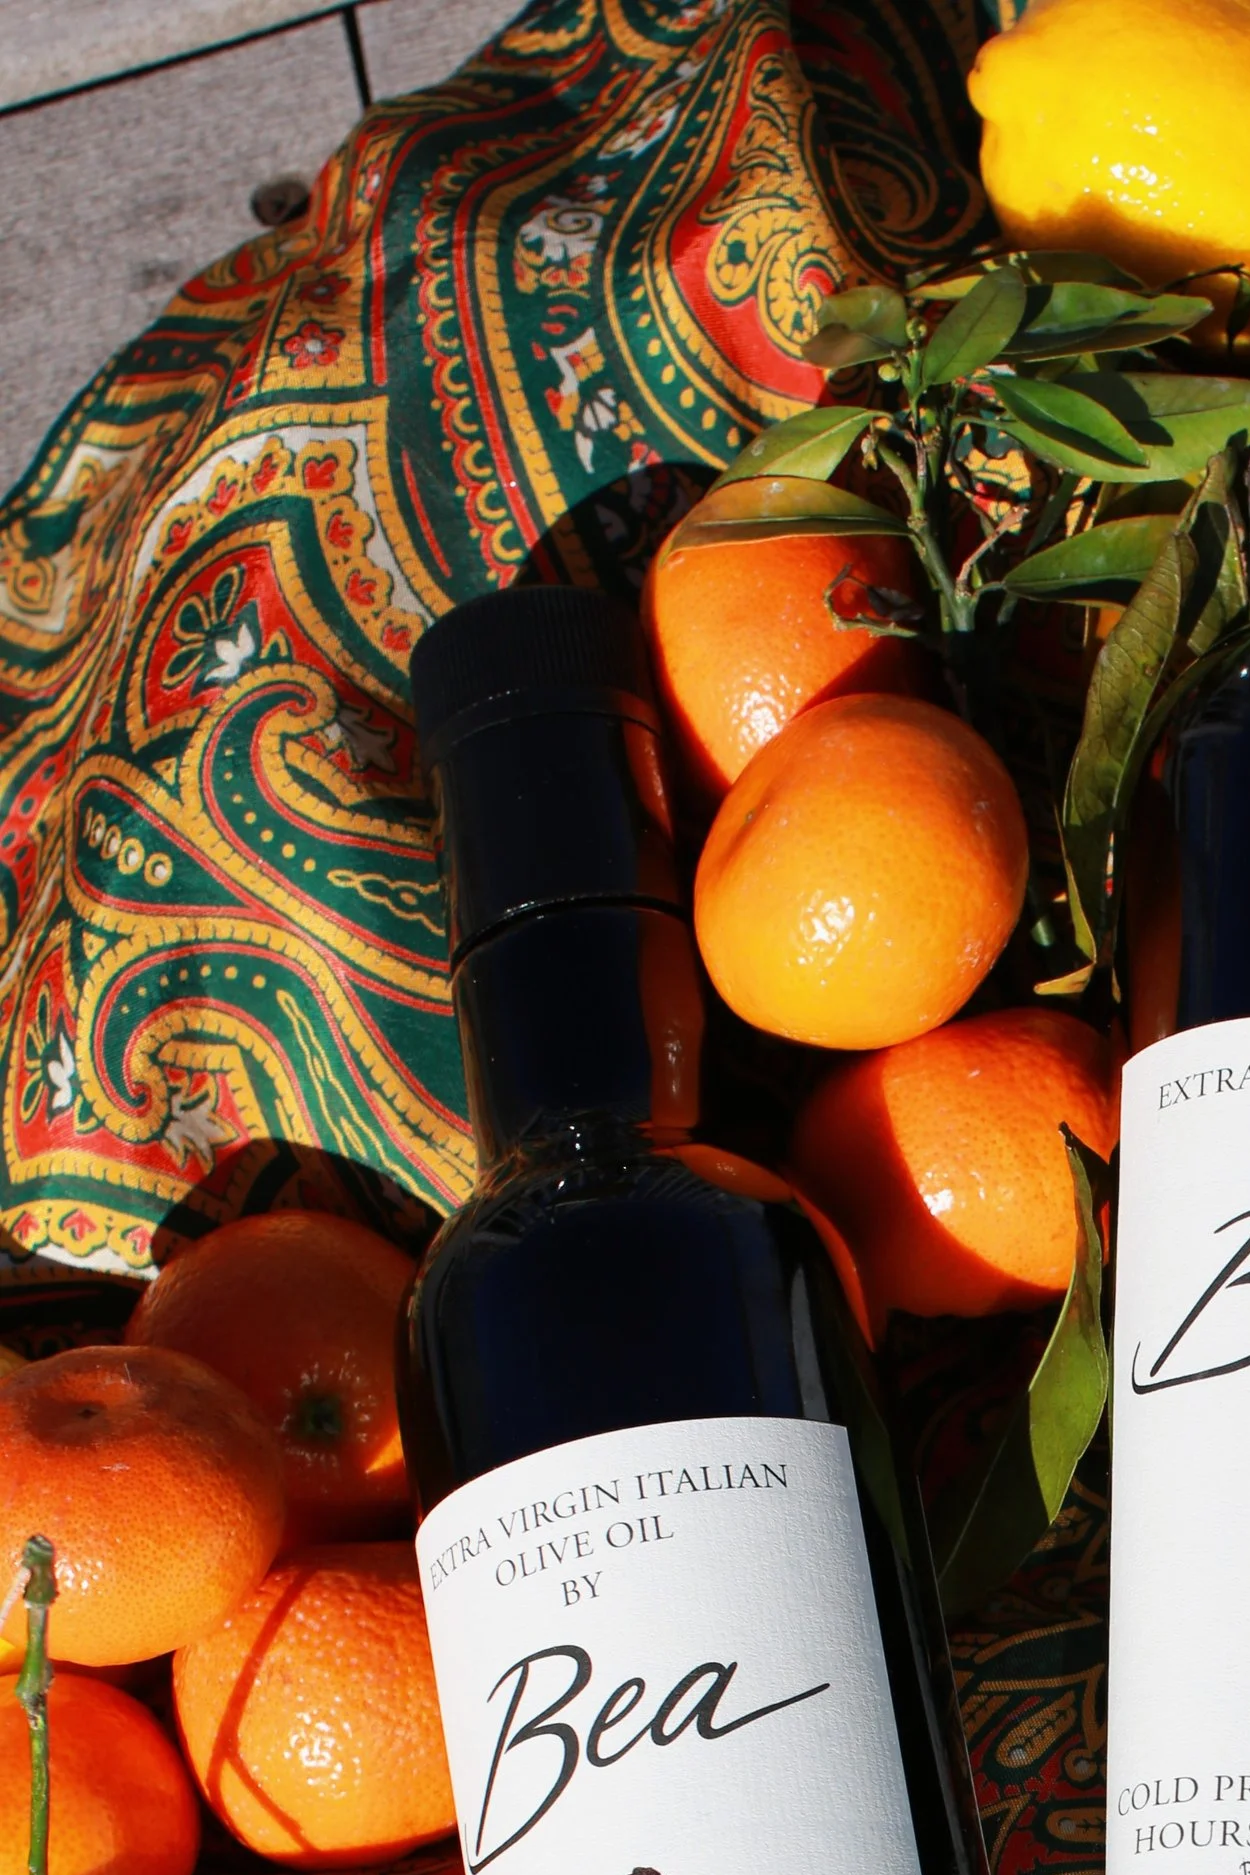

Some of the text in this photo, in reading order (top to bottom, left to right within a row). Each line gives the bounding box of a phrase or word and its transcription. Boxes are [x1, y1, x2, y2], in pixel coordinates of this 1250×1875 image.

[429, 1463, 788, 1593] EXTRA VIRGIN ITALIAN
[495, 1514, 674, 1587] OLIVE OIL
[560, 1570, 604, 1607] BY
[464, 1644, 831, 1875] Bea
[1118, 1776, 1199, 1817] COLD
